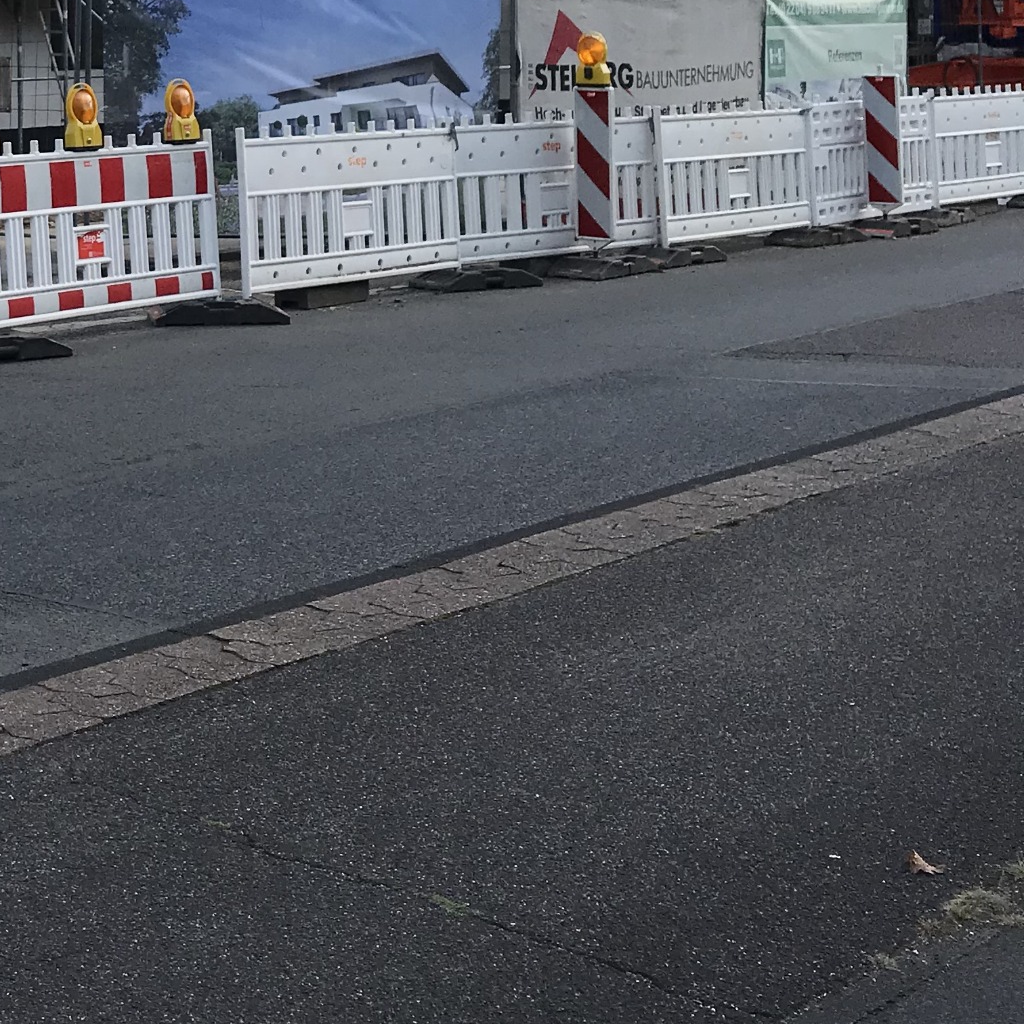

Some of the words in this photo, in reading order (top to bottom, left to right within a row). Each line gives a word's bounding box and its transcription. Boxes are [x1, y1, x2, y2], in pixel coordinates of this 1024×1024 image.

[636, 61, 754, 89] BAUUNTERNEHMUNG
[542, 141, 561, 153] step
[83, 233, 96, 243] step
